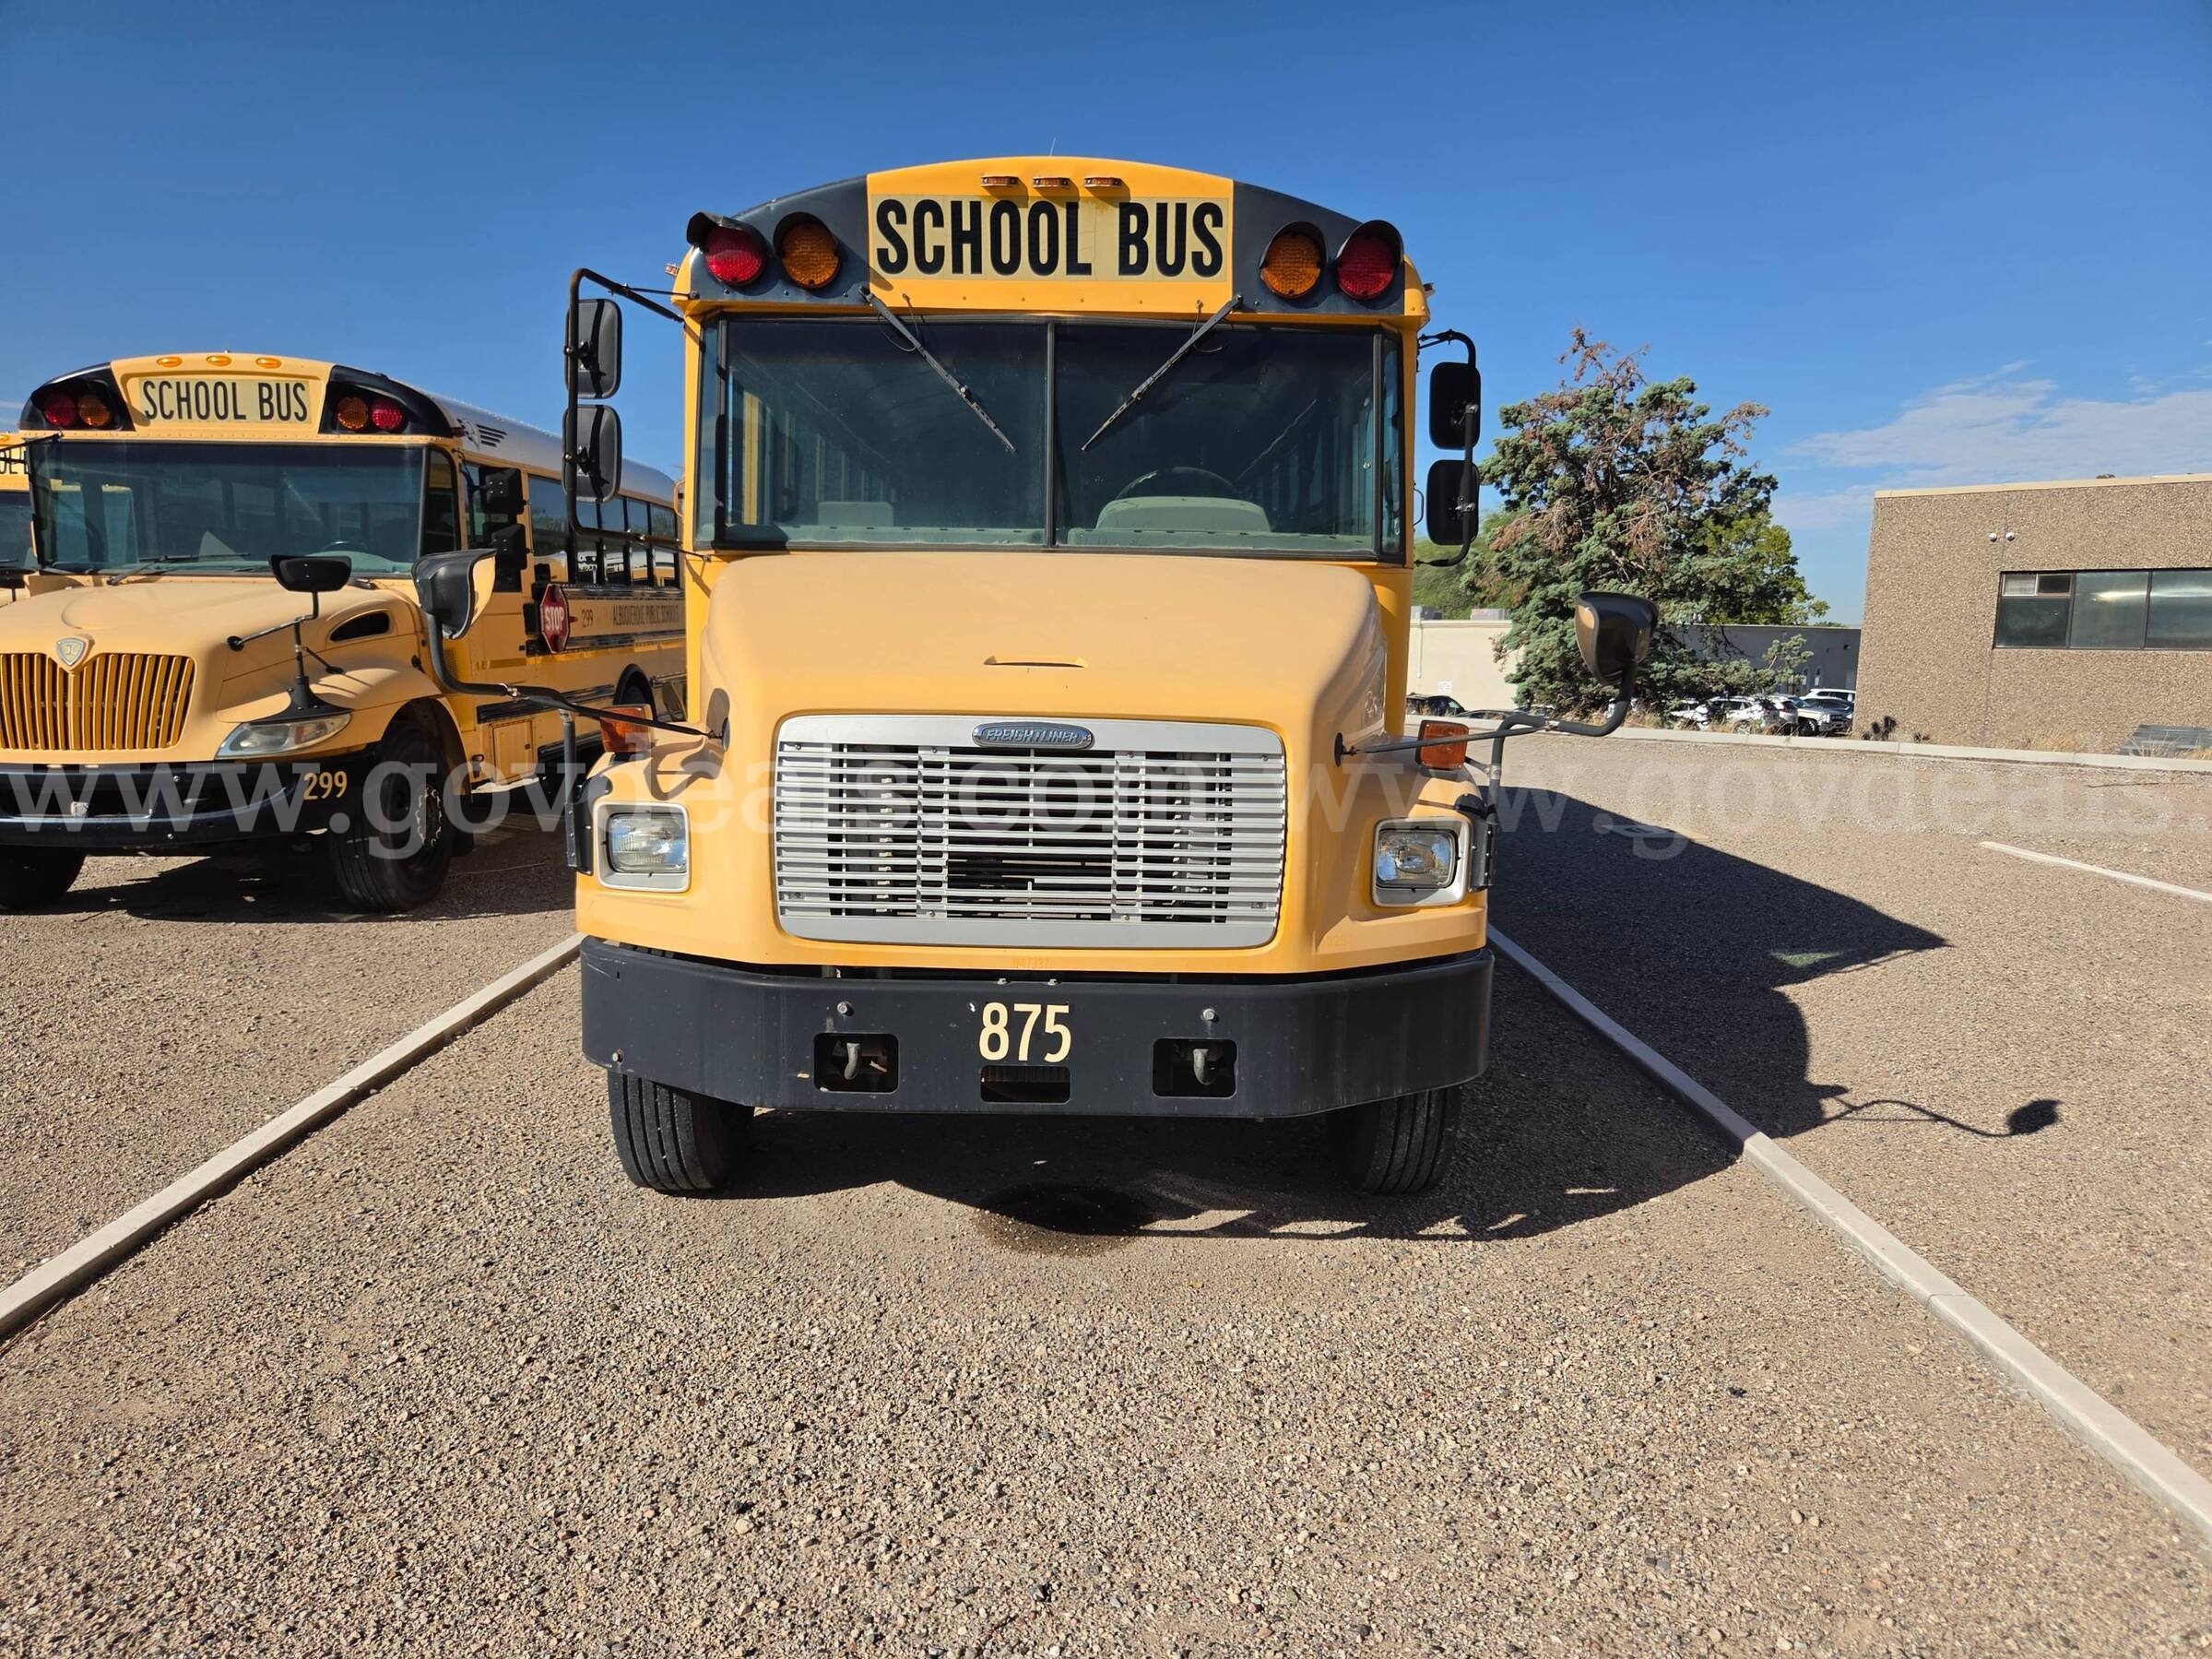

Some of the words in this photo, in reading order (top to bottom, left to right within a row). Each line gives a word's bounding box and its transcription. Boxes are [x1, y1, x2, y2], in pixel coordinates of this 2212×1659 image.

[876, 198, 1093, 276] SCHOOL
[1118, 201, 1224, 277] BUS
[143, 380, 247, 421] SCHOOL
[257, 382, 308, 421] BUS
[544, 606, 565, 632] STOP
[582, 609, 594, 628] 299
[986, 728, 1079, 743] FREIGHTLINER
[302, 771, 348, 800] 299
[979, 1002, 1071, 1062] 875
